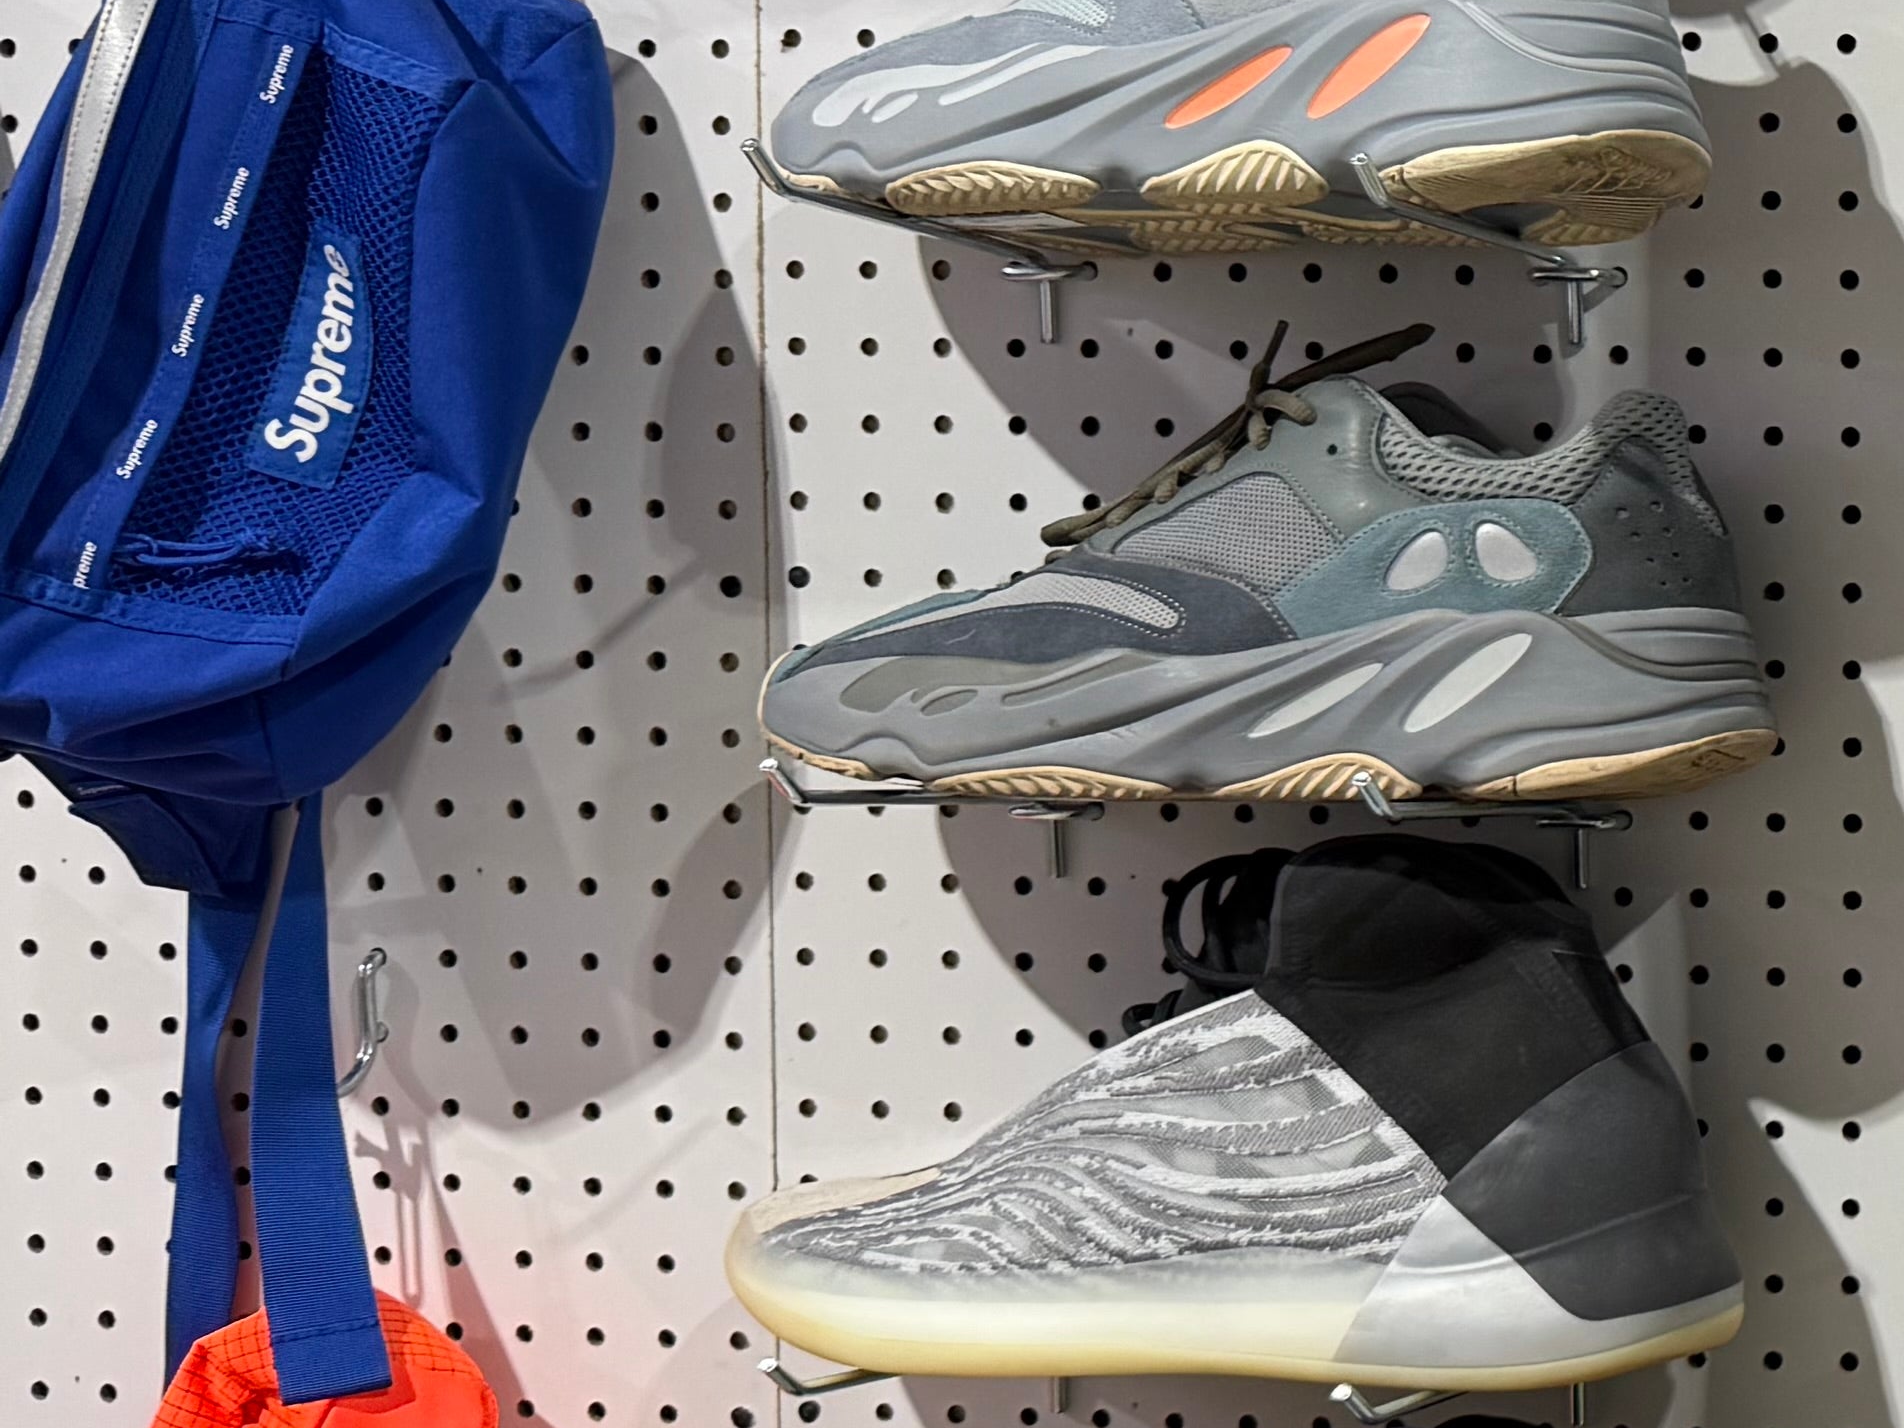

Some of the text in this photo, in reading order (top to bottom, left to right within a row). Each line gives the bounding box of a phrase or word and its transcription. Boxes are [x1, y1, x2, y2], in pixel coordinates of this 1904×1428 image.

[259, 44, 295, 104] Supreme
[213, 166, 250, 230] Supreme
[171, 293, 205, 357] Supreme
[264, 244, 355, 464] Supreme
[116, 419, 158, 479] Supreme
